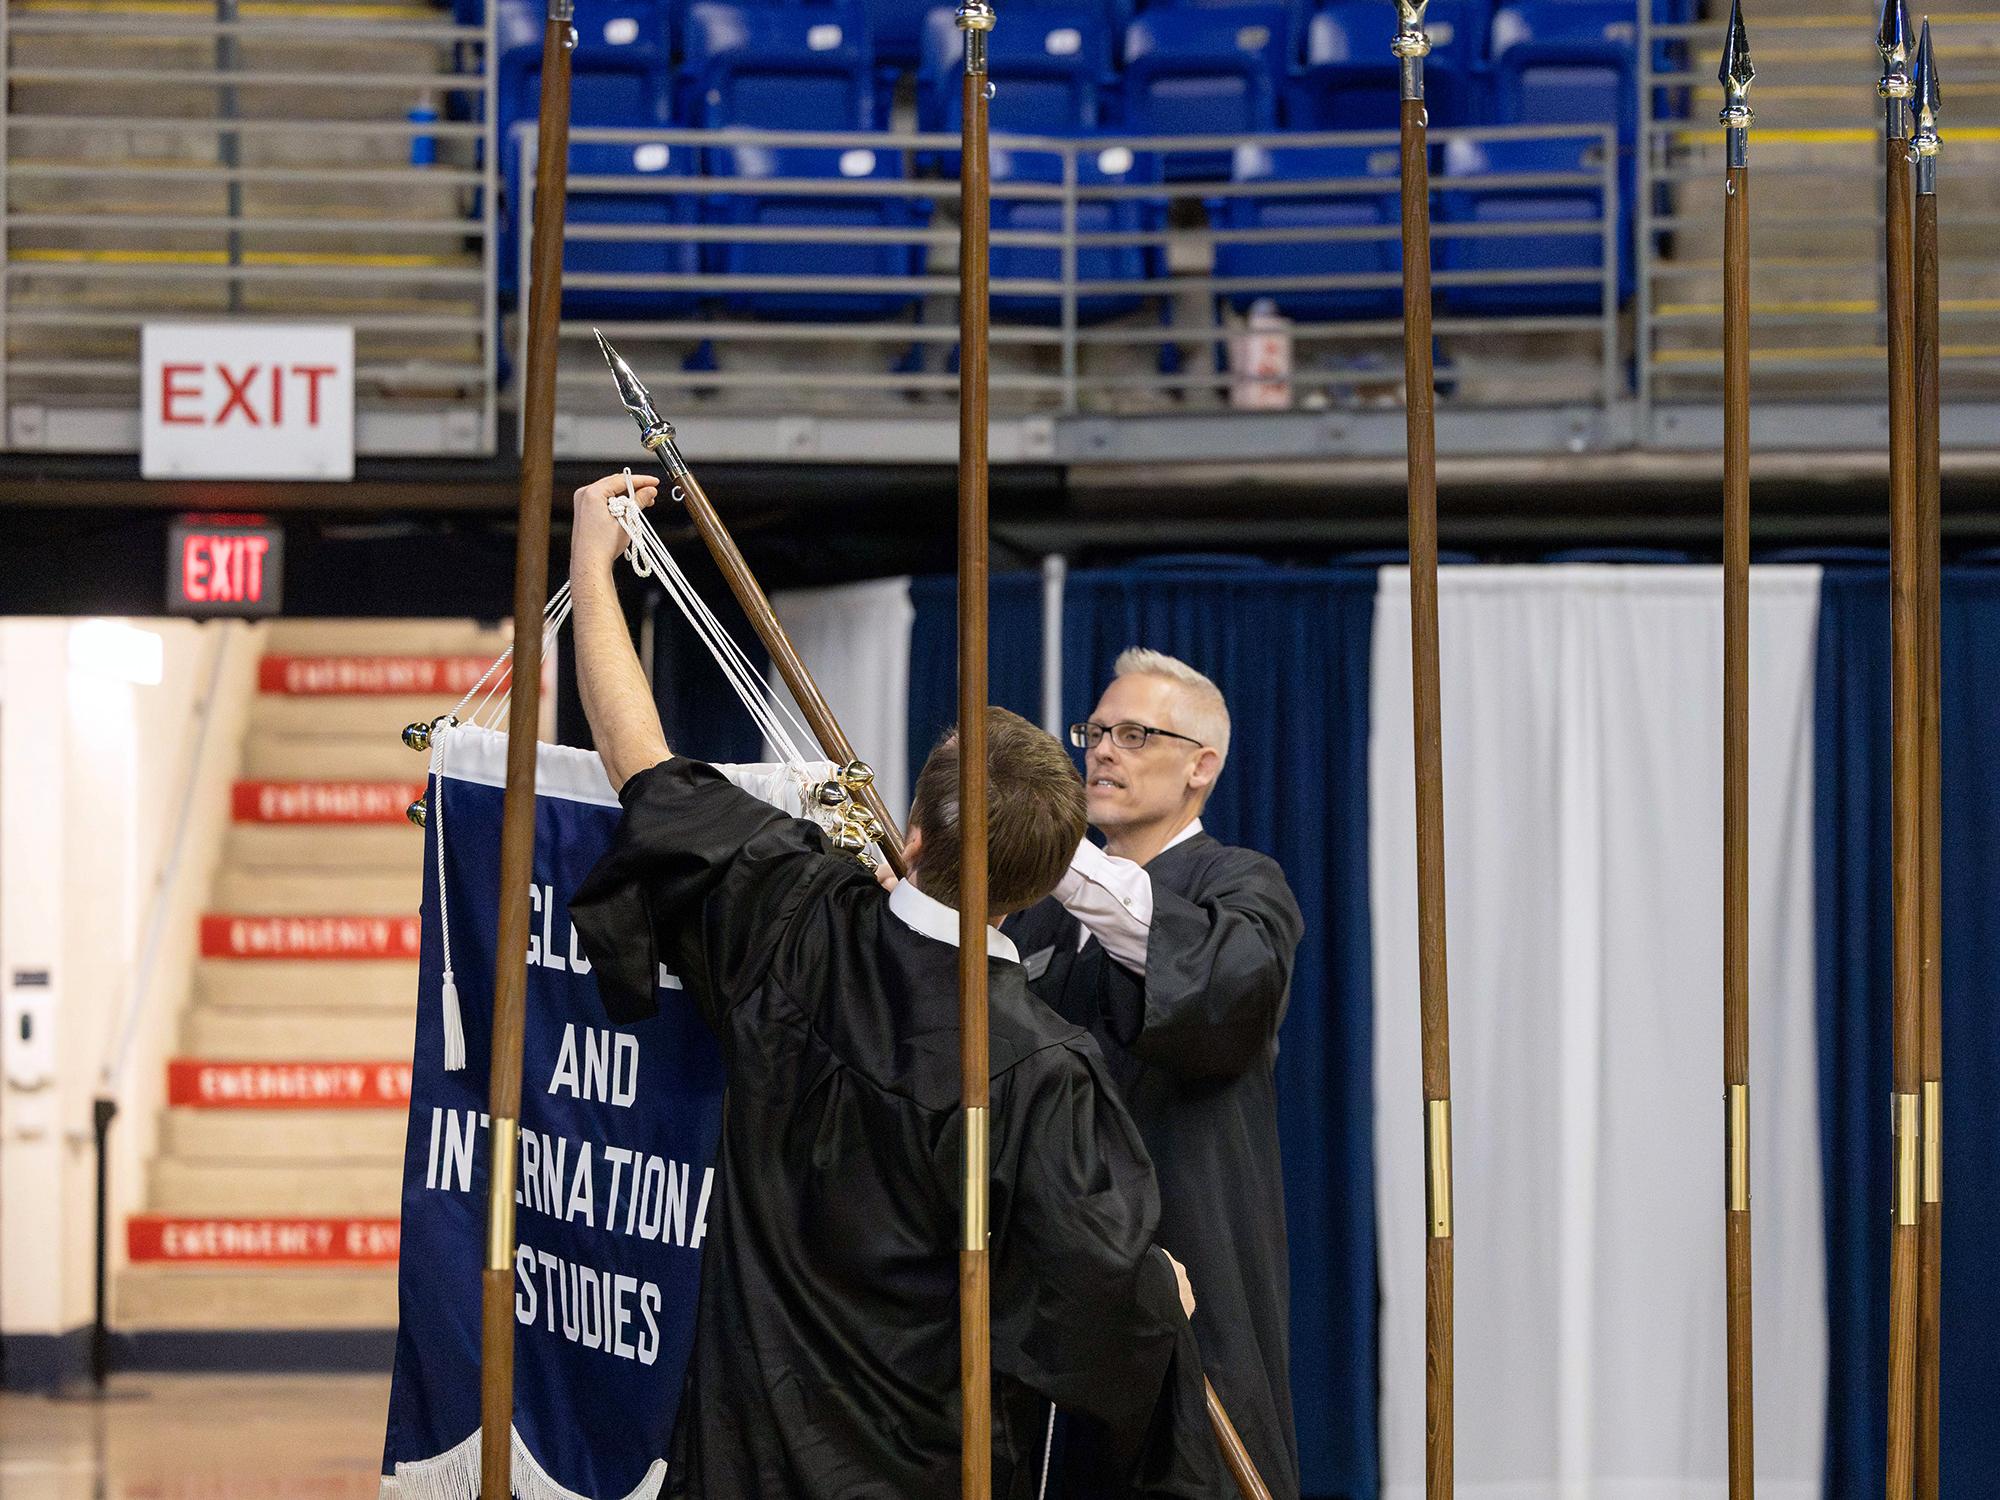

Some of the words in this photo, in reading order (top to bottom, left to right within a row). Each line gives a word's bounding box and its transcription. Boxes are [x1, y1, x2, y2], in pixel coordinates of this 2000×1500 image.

[160, 362, 337, 427] EXIT
[183, 535, 269, 602] EXIT
[548, 1023, 639, 1108] AND
[515, 1243, 662, 1366] STUDIES
